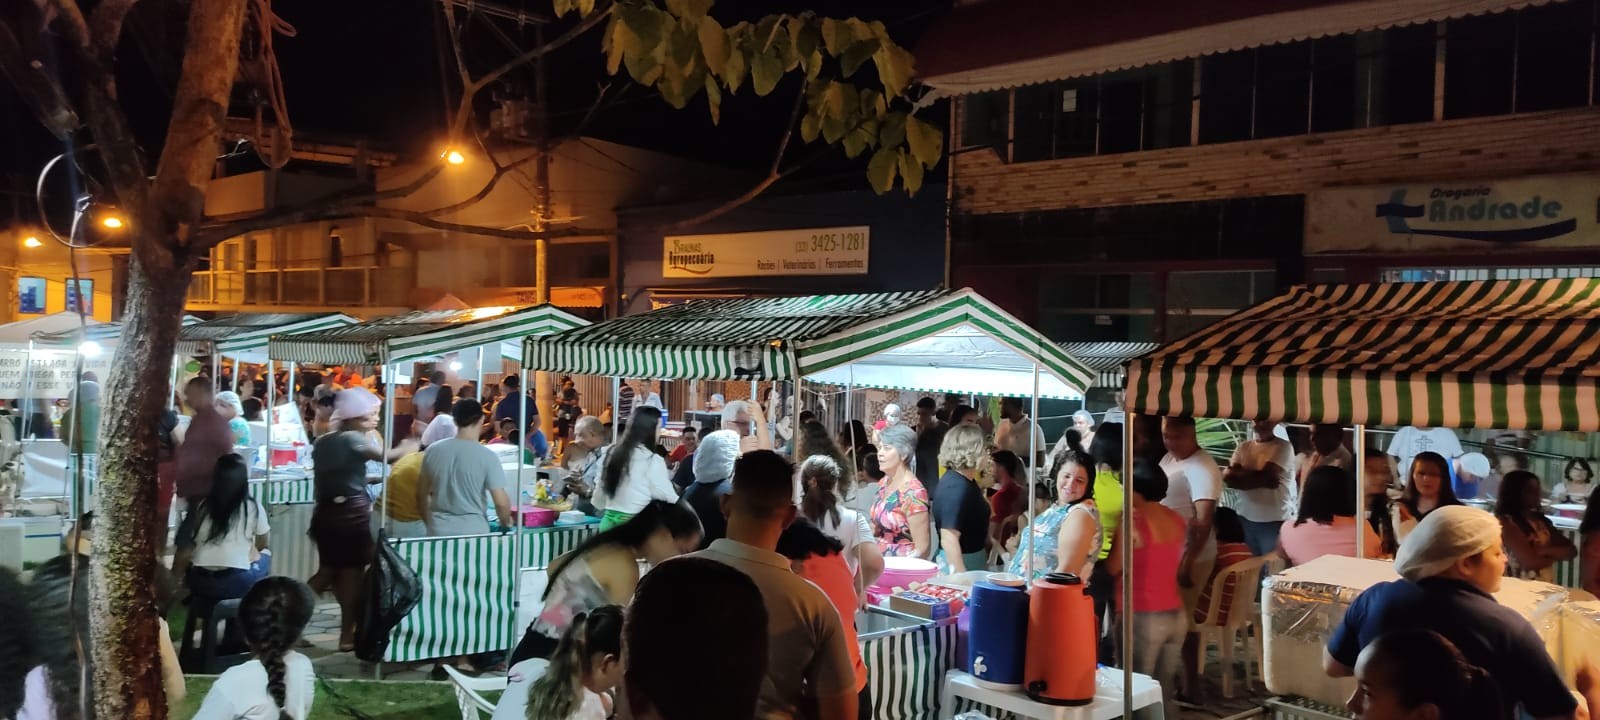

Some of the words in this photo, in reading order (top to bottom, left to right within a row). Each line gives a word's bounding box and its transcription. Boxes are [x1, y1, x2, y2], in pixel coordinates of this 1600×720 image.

[1430, 185, 1491, 201] Drogaria
[1429, 195, 1563, 222] Andrade
[811, 232, 865, 252] 3425-1281
[825, 257, 864, 269] Ferramentas
